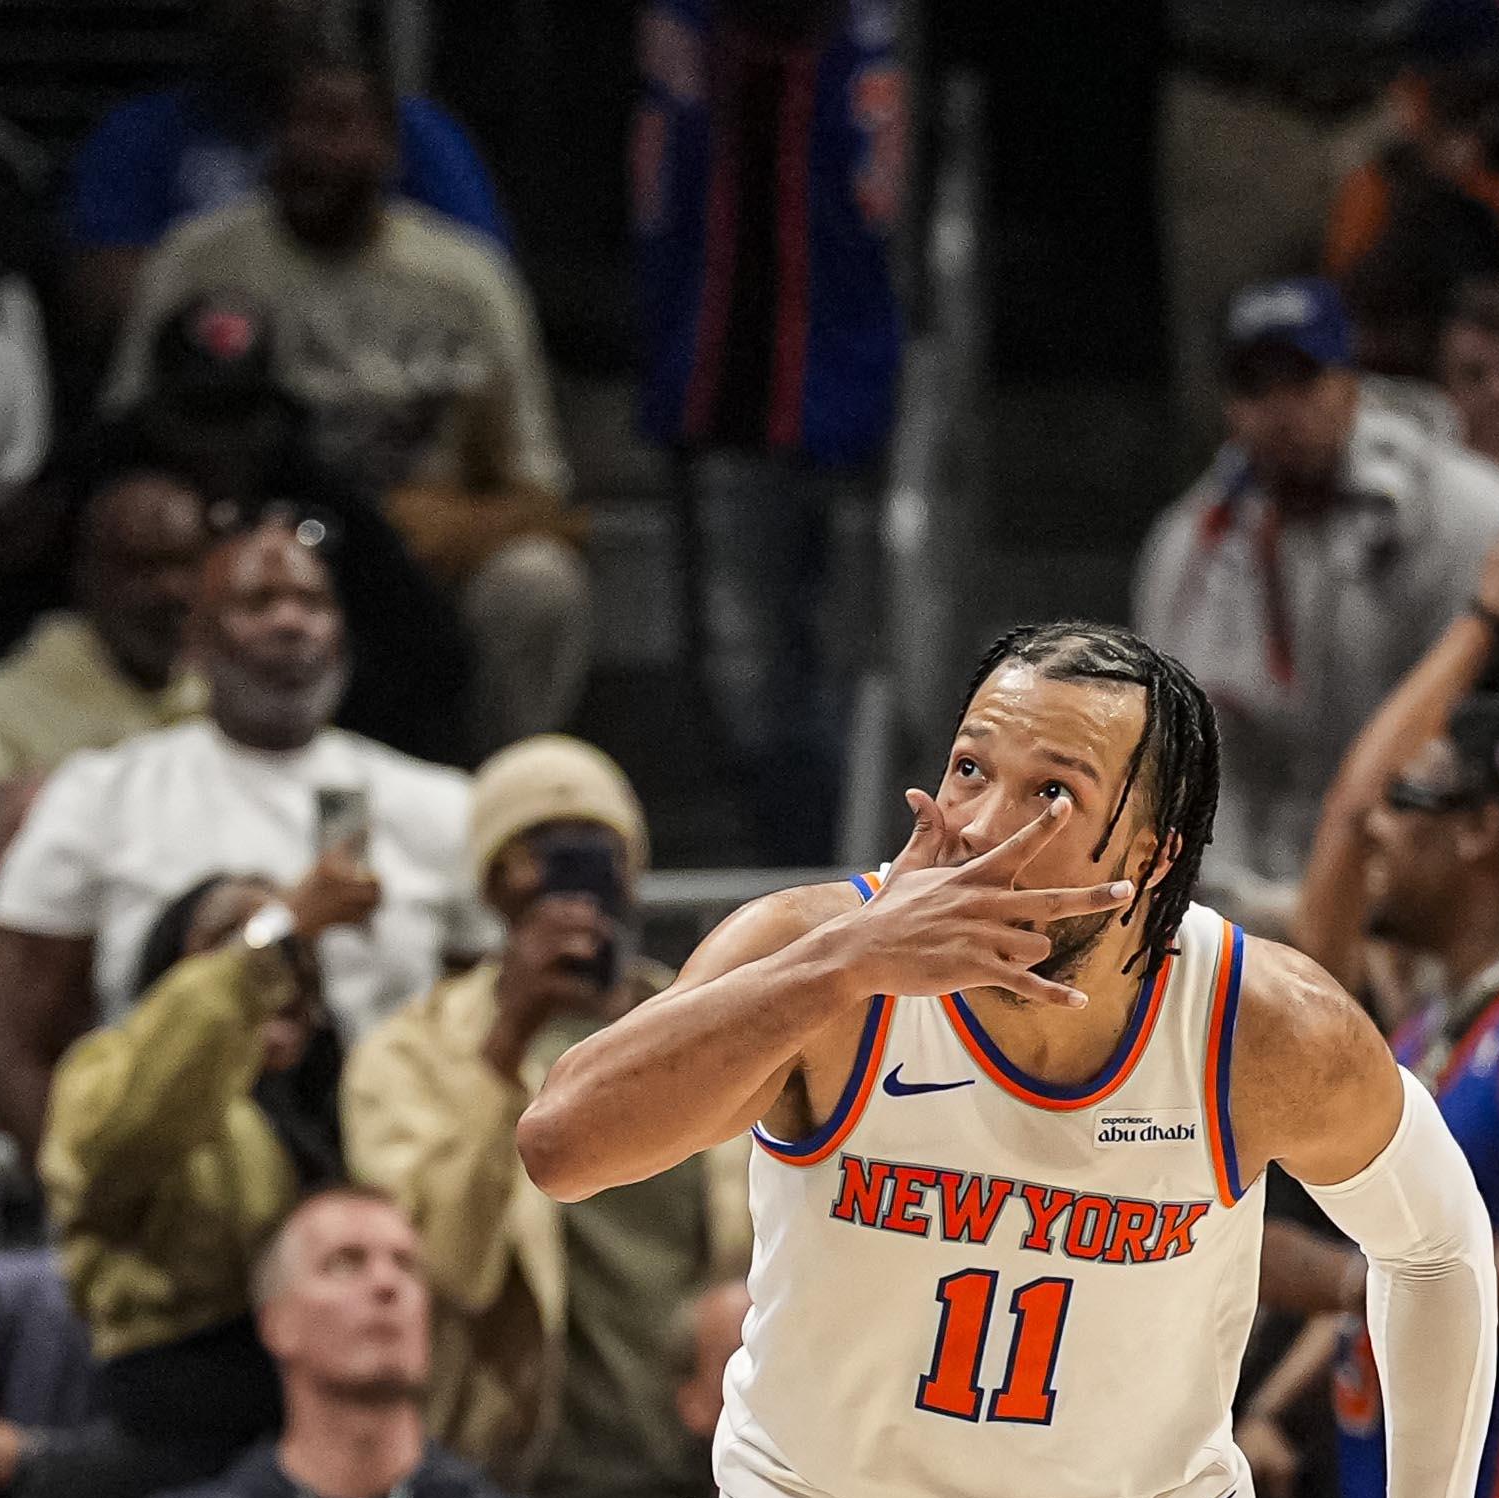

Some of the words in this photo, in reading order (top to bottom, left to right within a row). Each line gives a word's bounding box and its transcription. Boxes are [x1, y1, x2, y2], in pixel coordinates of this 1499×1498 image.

[1098, 1126, 1136, 1142] abu
[1140, 1123, 1196, 1141] dhabi
[1101, 1116, 1153, 1126] experience
[830, 1152, 1015, 1247] NEW
[1019, 1182, 1212, 1267] YORK
[914, 1268, 1074, 1427] 11
